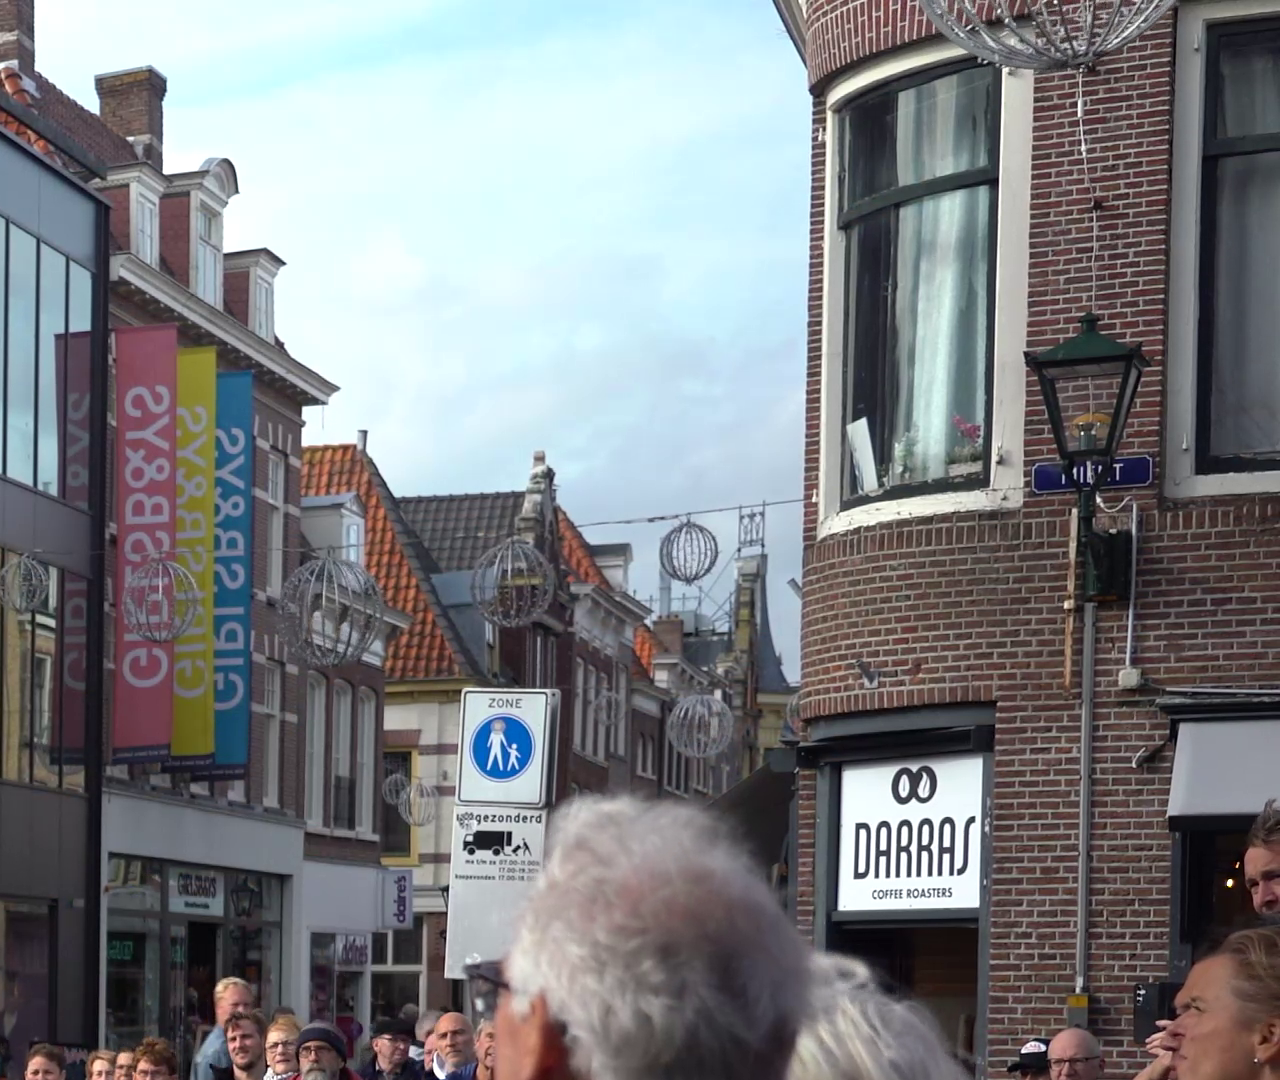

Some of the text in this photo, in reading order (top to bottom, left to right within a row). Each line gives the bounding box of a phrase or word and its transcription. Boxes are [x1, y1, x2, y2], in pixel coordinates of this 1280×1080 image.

[488, 697, 523, 709] ZONE
[853, 816, 976, 880] DARRAS
[871, 887, 953, 900] COFFEE ROASTERS
